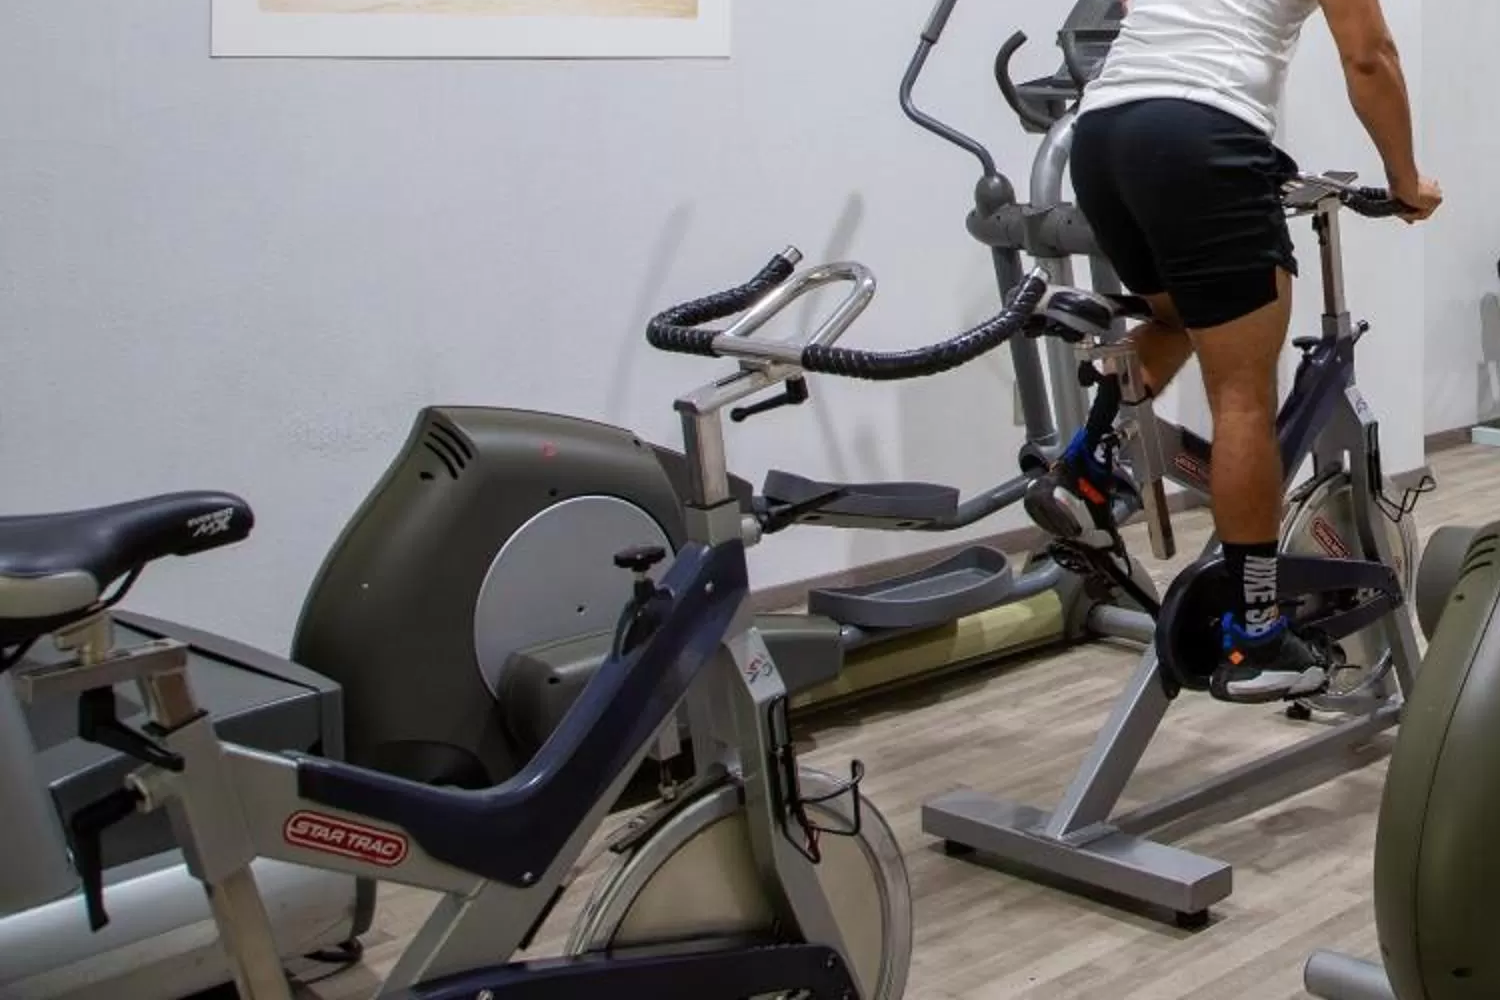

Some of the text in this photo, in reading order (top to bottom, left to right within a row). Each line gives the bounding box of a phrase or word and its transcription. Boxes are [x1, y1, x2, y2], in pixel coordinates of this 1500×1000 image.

[1243, 554, 1278, 604] NIKE
[290, 820, 400, 856] STAR TRAC
